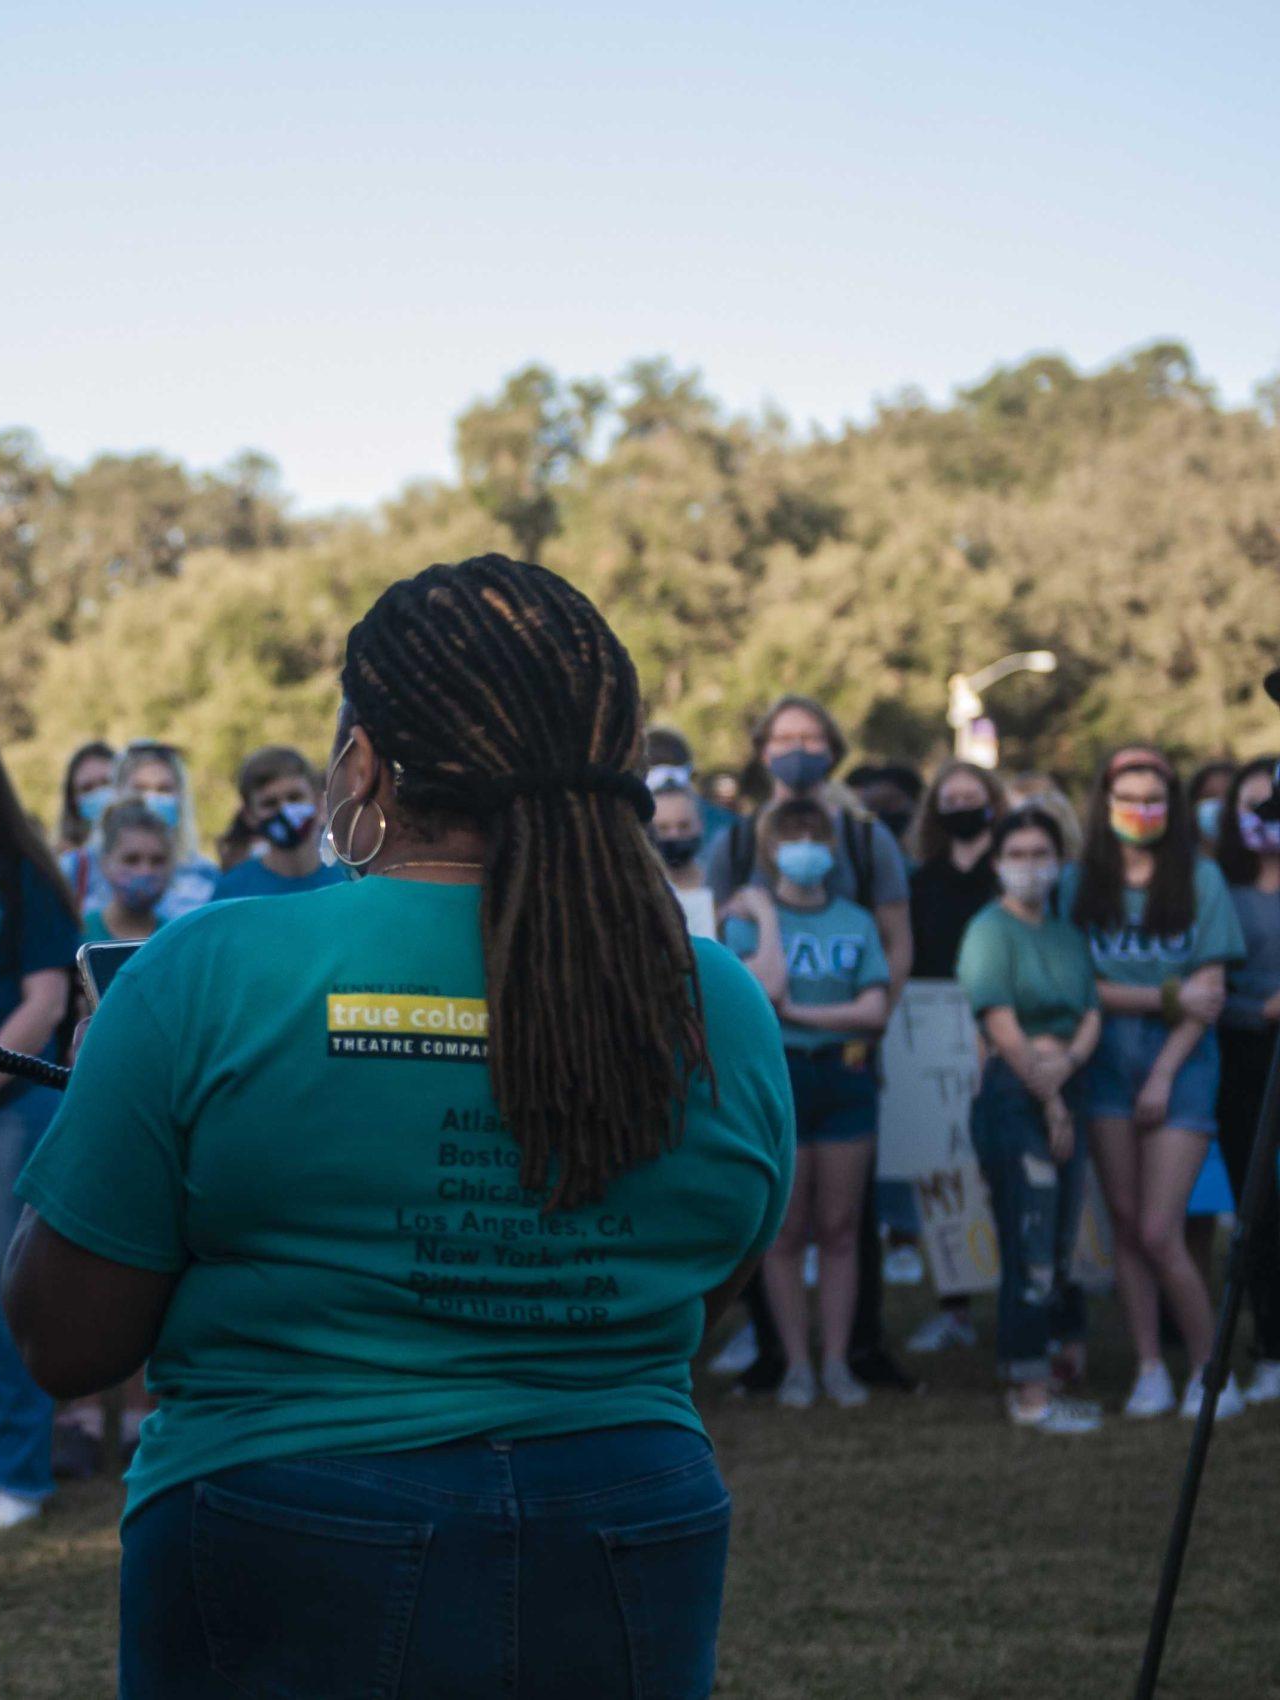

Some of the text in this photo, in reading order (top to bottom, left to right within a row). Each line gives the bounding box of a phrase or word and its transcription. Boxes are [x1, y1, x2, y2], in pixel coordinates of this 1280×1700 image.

[332, 1002, 488, 1032] true color
[331, 1036, 414, 1055] THEATRE
[439, 1107, 500, 1133] Atla
[436, 1142, 521, 1168] Bosto
[396, 1206, 448, 1233] Los
[597, 1214, 635, 1237] CA
[414, 1236, 481, 1264] New
[582, 1275, 620, 1297] PA
